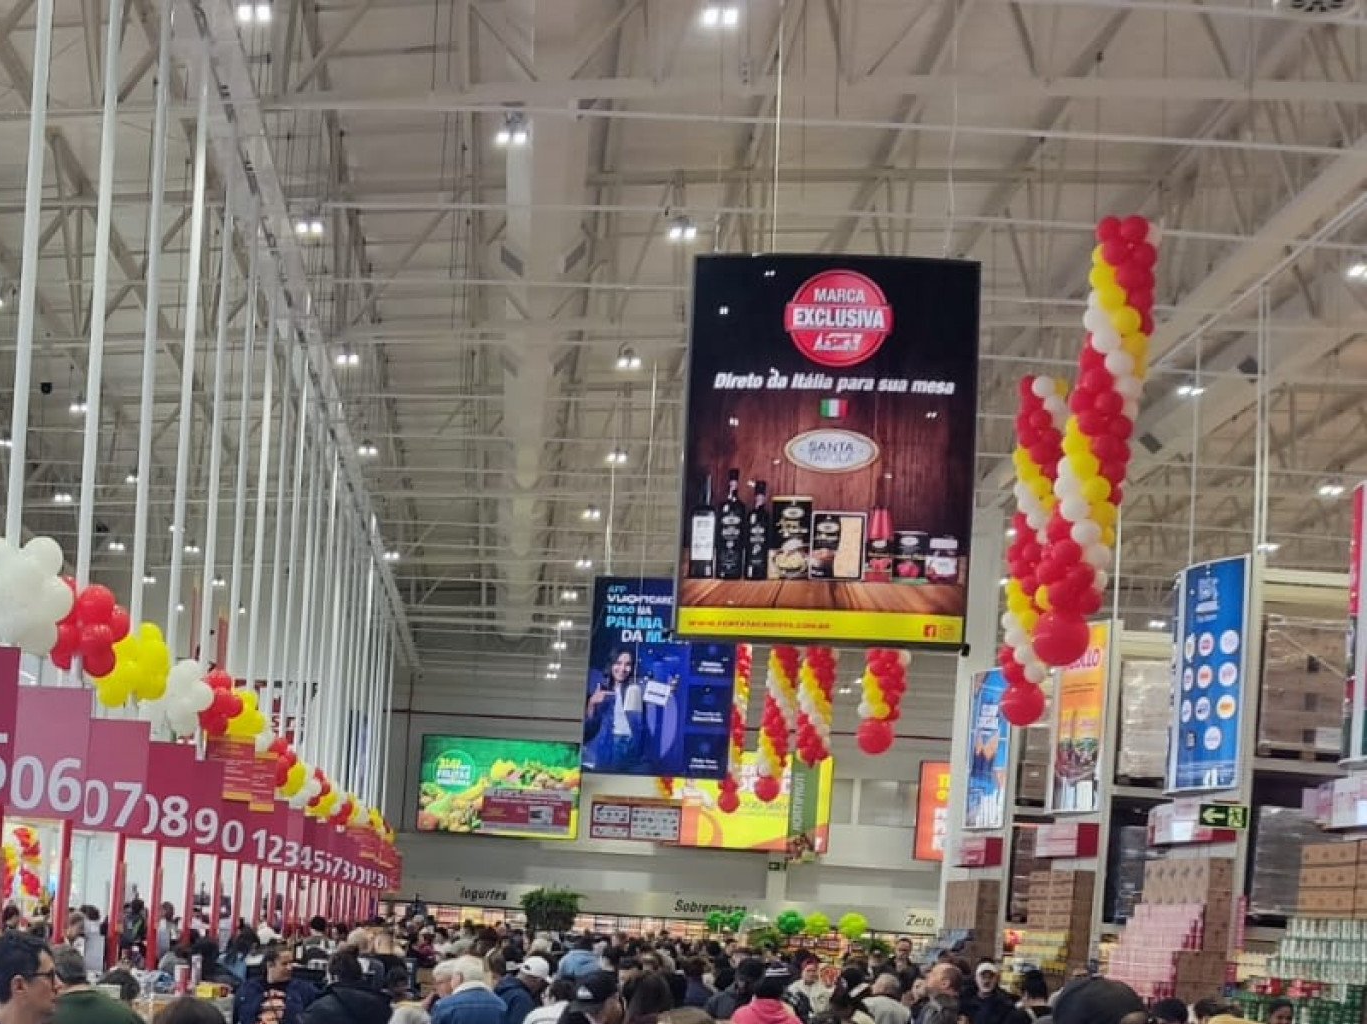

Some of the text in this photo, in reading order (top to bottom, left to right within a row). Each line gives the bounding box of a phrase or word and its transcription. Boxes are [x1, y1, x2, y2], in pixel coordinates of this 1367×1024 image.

[814, 287, 865, 304] MARCA
[793, 307, 885, 329] EXCLUSIVA
[714, 373, 763, 390] Direto
[836, 376, 875, 394] para
[877, 378, 908, 393] sua
[911, 380, 955, 395] mesa
[606, 615, 663, 630] PALMA
[621, 629, 643, 643] DA
[10, 755, 83, 812] 06
[192, 808, 220, 844] 9
[460, 886, 507, 902] Iogurtes
[906, 914, 936, 928] Zero
